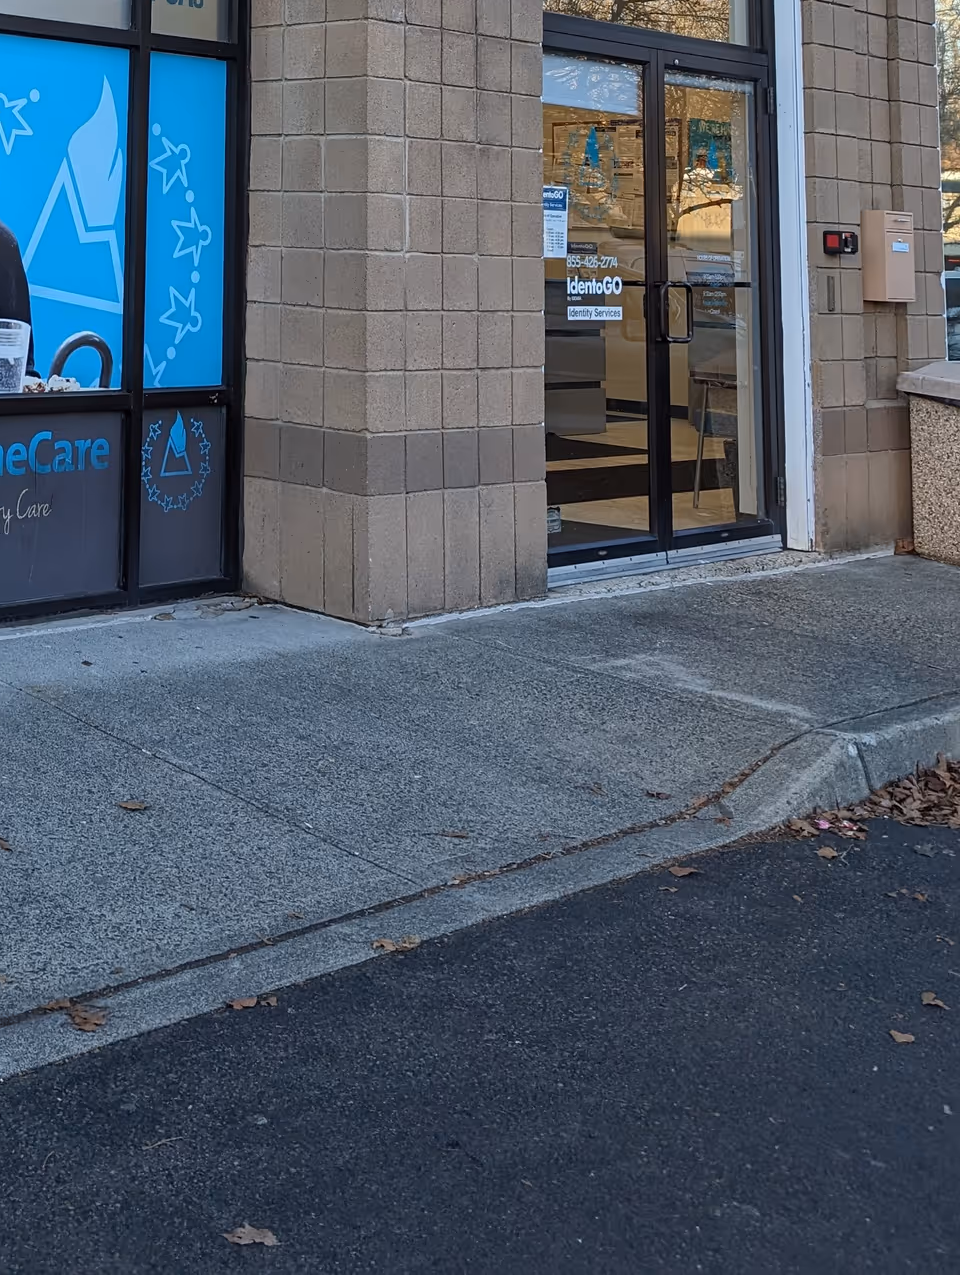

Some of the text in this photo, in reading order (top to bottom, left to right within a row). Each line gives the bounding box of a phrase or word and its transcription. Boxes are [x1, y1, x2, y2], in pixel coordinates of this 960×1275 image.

[566, 255, 618, 269] 855-426-2774
[566, 275, 622, 295] IdentoGO
[568, 308, 621, 319] Identity Services
[16, 488, 53, 520] Care
